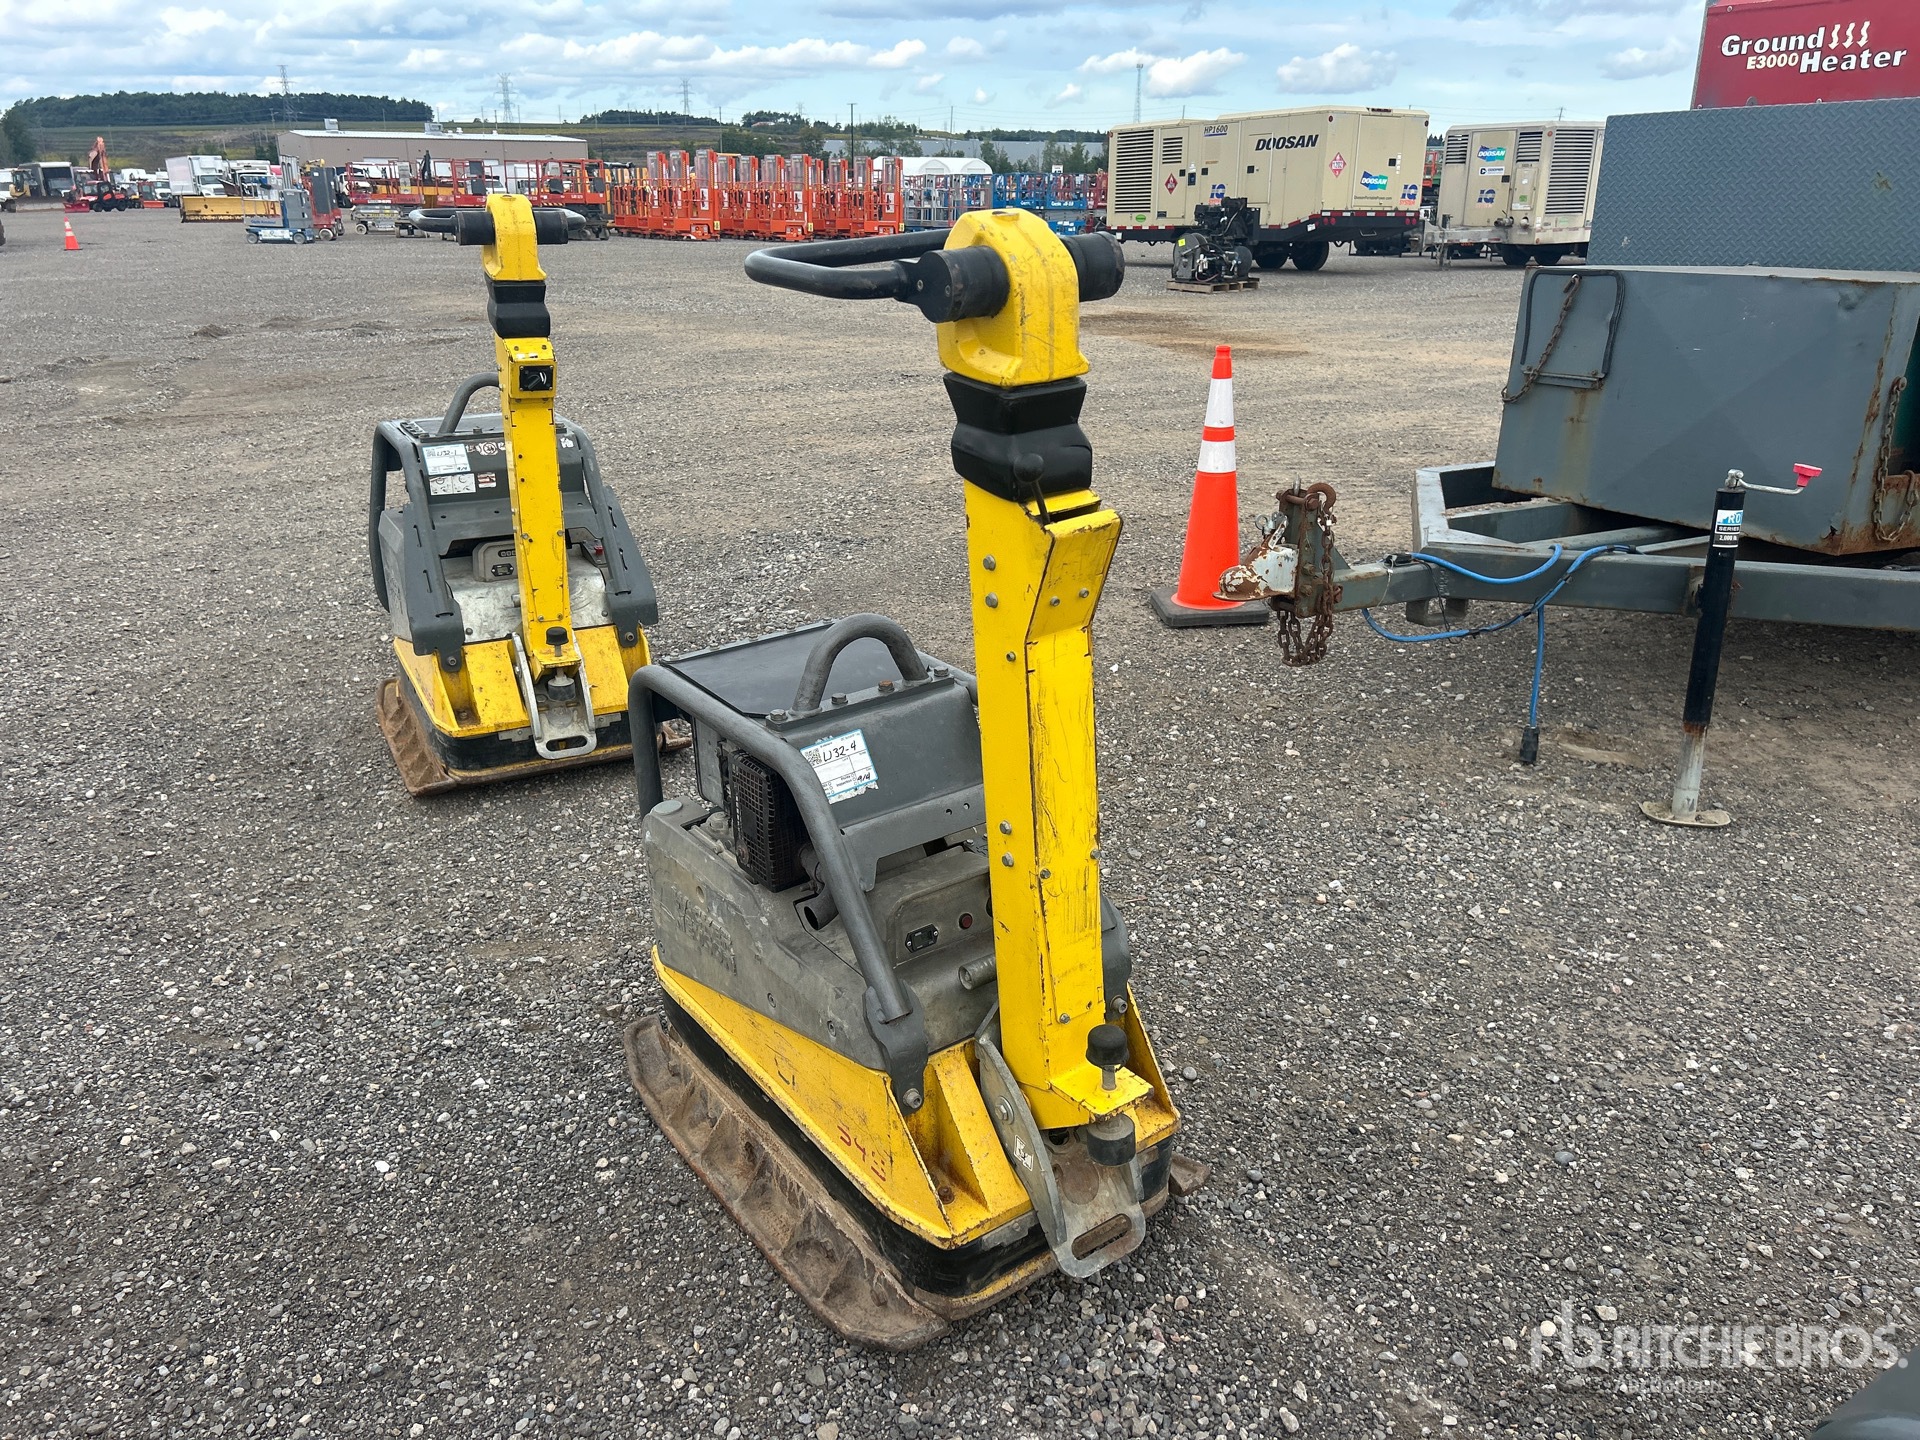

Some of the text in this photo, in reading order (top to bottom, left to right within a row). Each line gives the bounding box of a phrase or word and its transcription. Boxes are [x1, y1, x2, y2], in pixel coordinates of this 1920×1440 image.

[1721, 26, 1826, 57] Ground
[1746, 49, 1908, 74] E3000 Heater
[1204, 125, 1228, 134] HP1600
[1255, 134, 1319, 151] DOOSAN
[1361, 177, 1388, 185] DOOSAN
